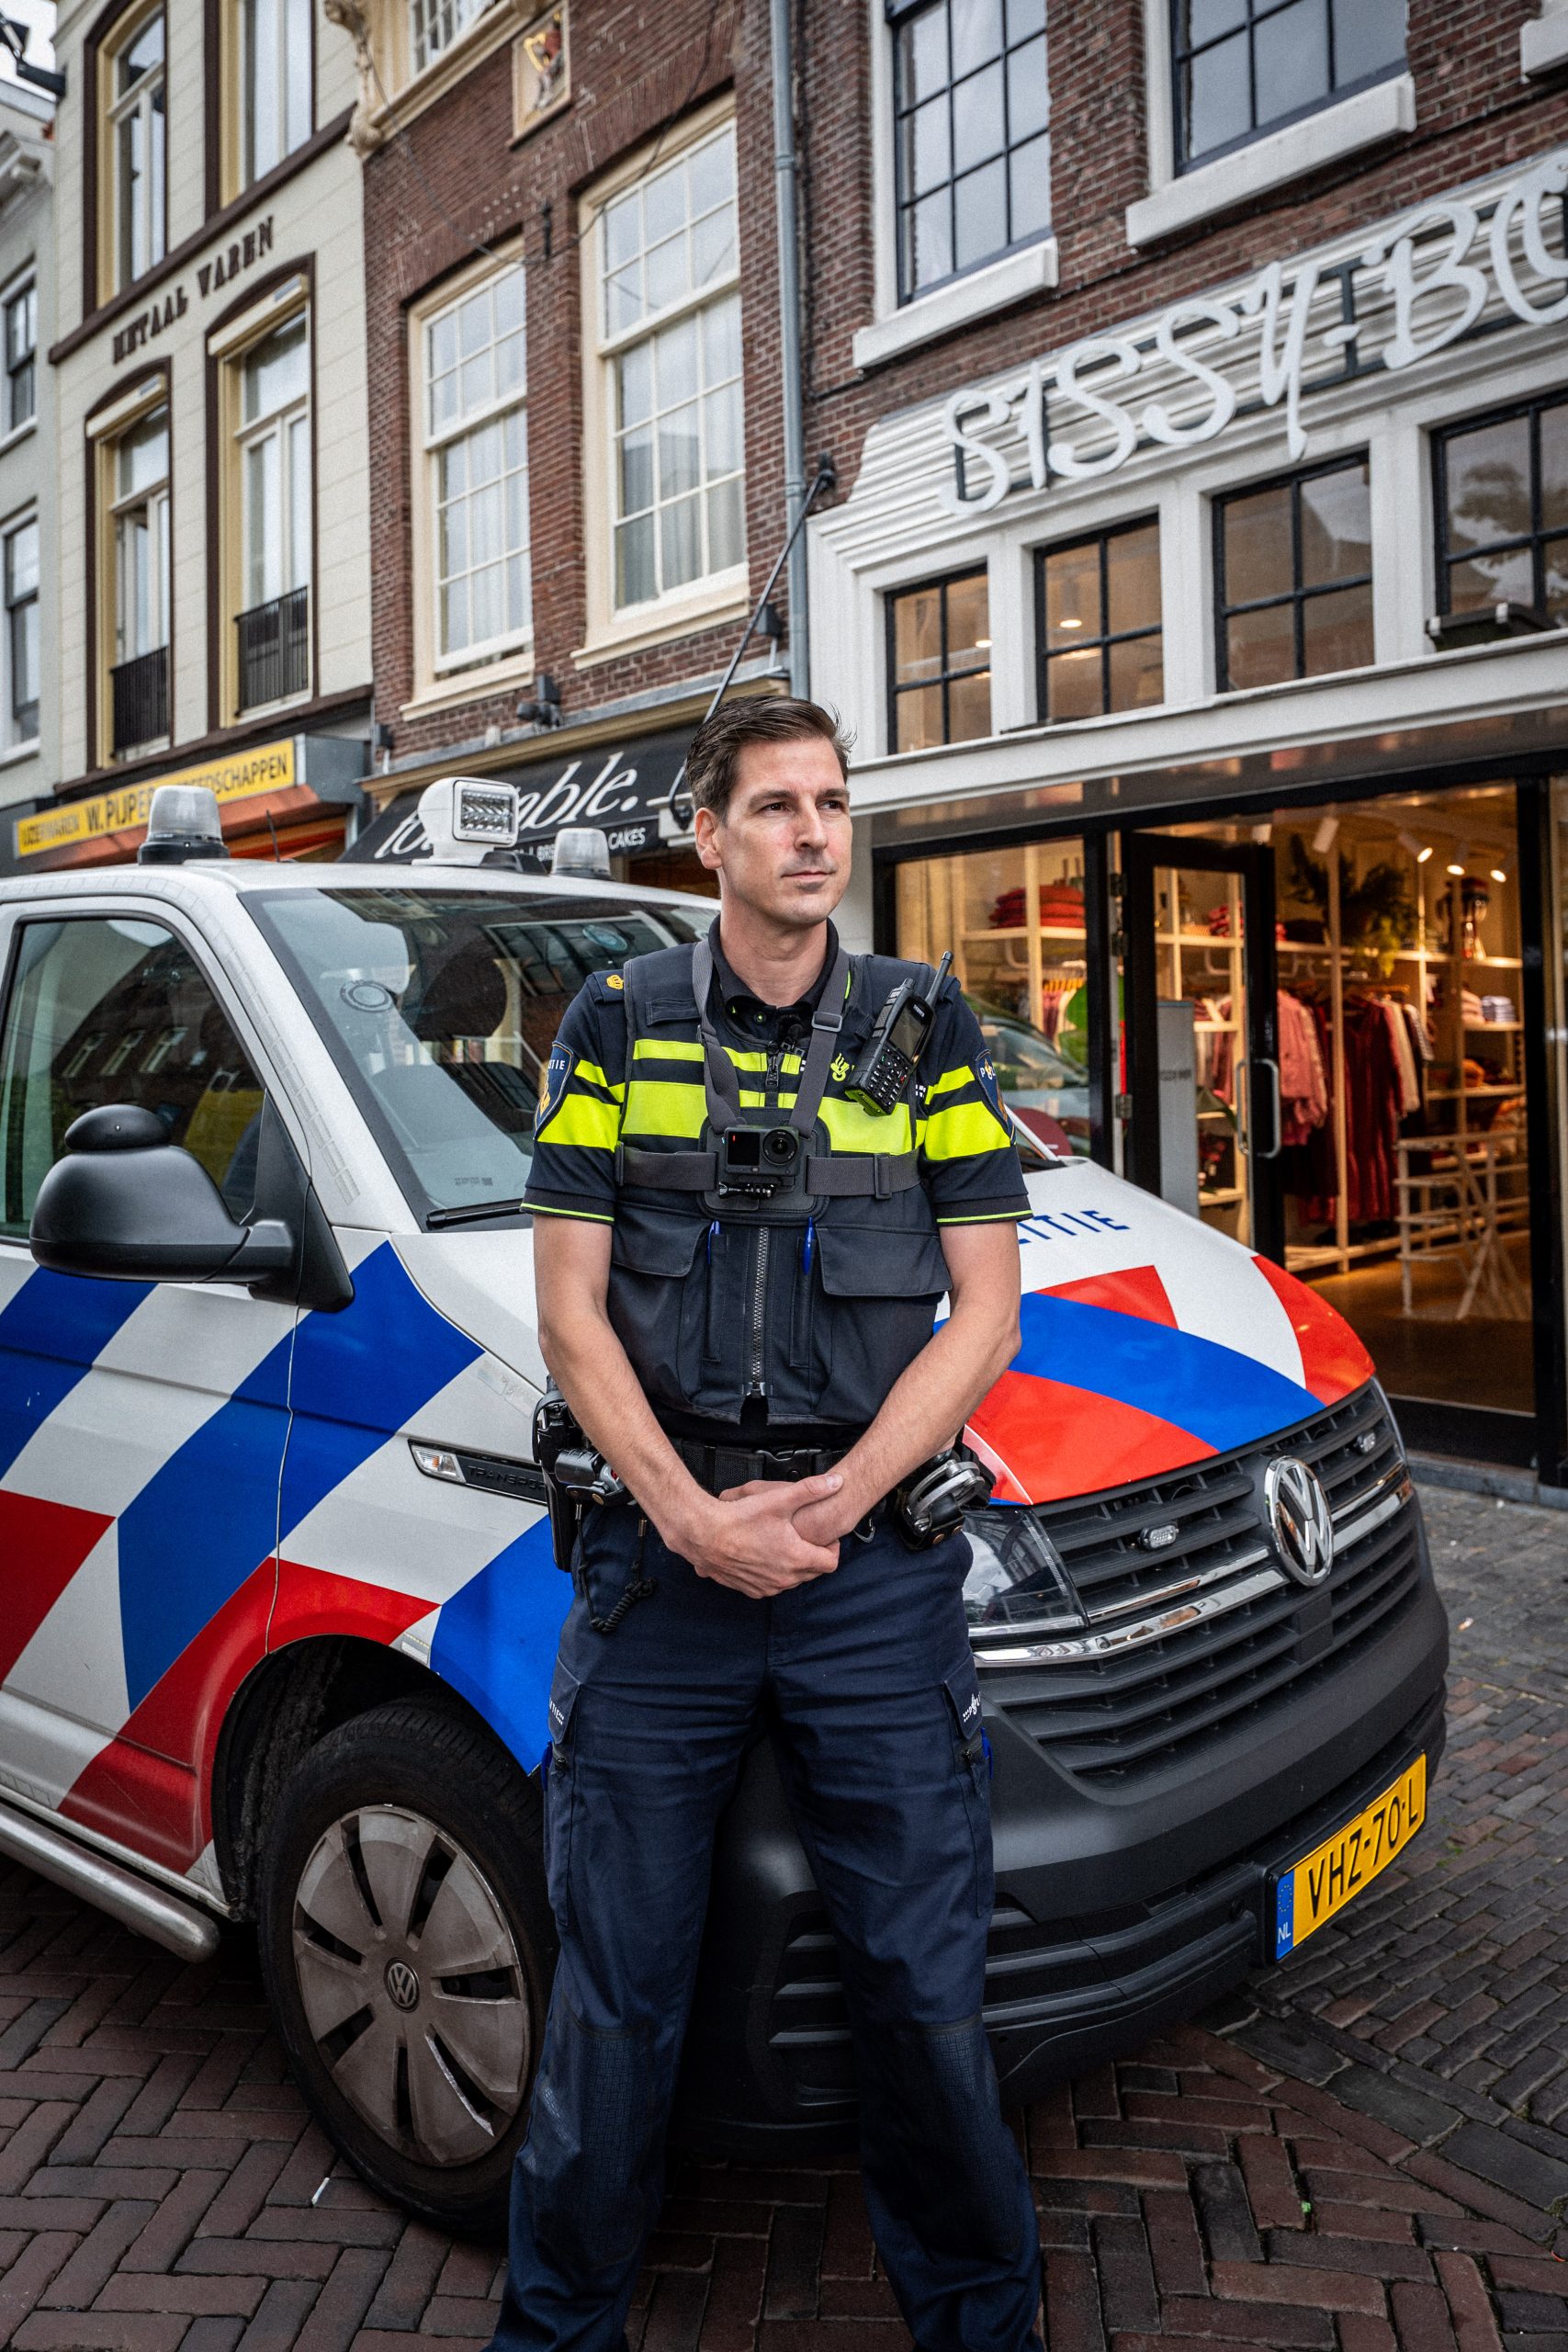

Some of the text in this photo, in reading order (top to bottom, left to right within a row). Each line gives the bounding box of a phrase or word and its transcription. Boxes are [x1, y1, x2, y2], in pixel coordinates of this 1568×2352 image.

[608, 827, 646, 850] CAKES
[1308, 1777, 1419, 1919] VHZ-70-L
[1277, 1921, 1292, 1944] NL
